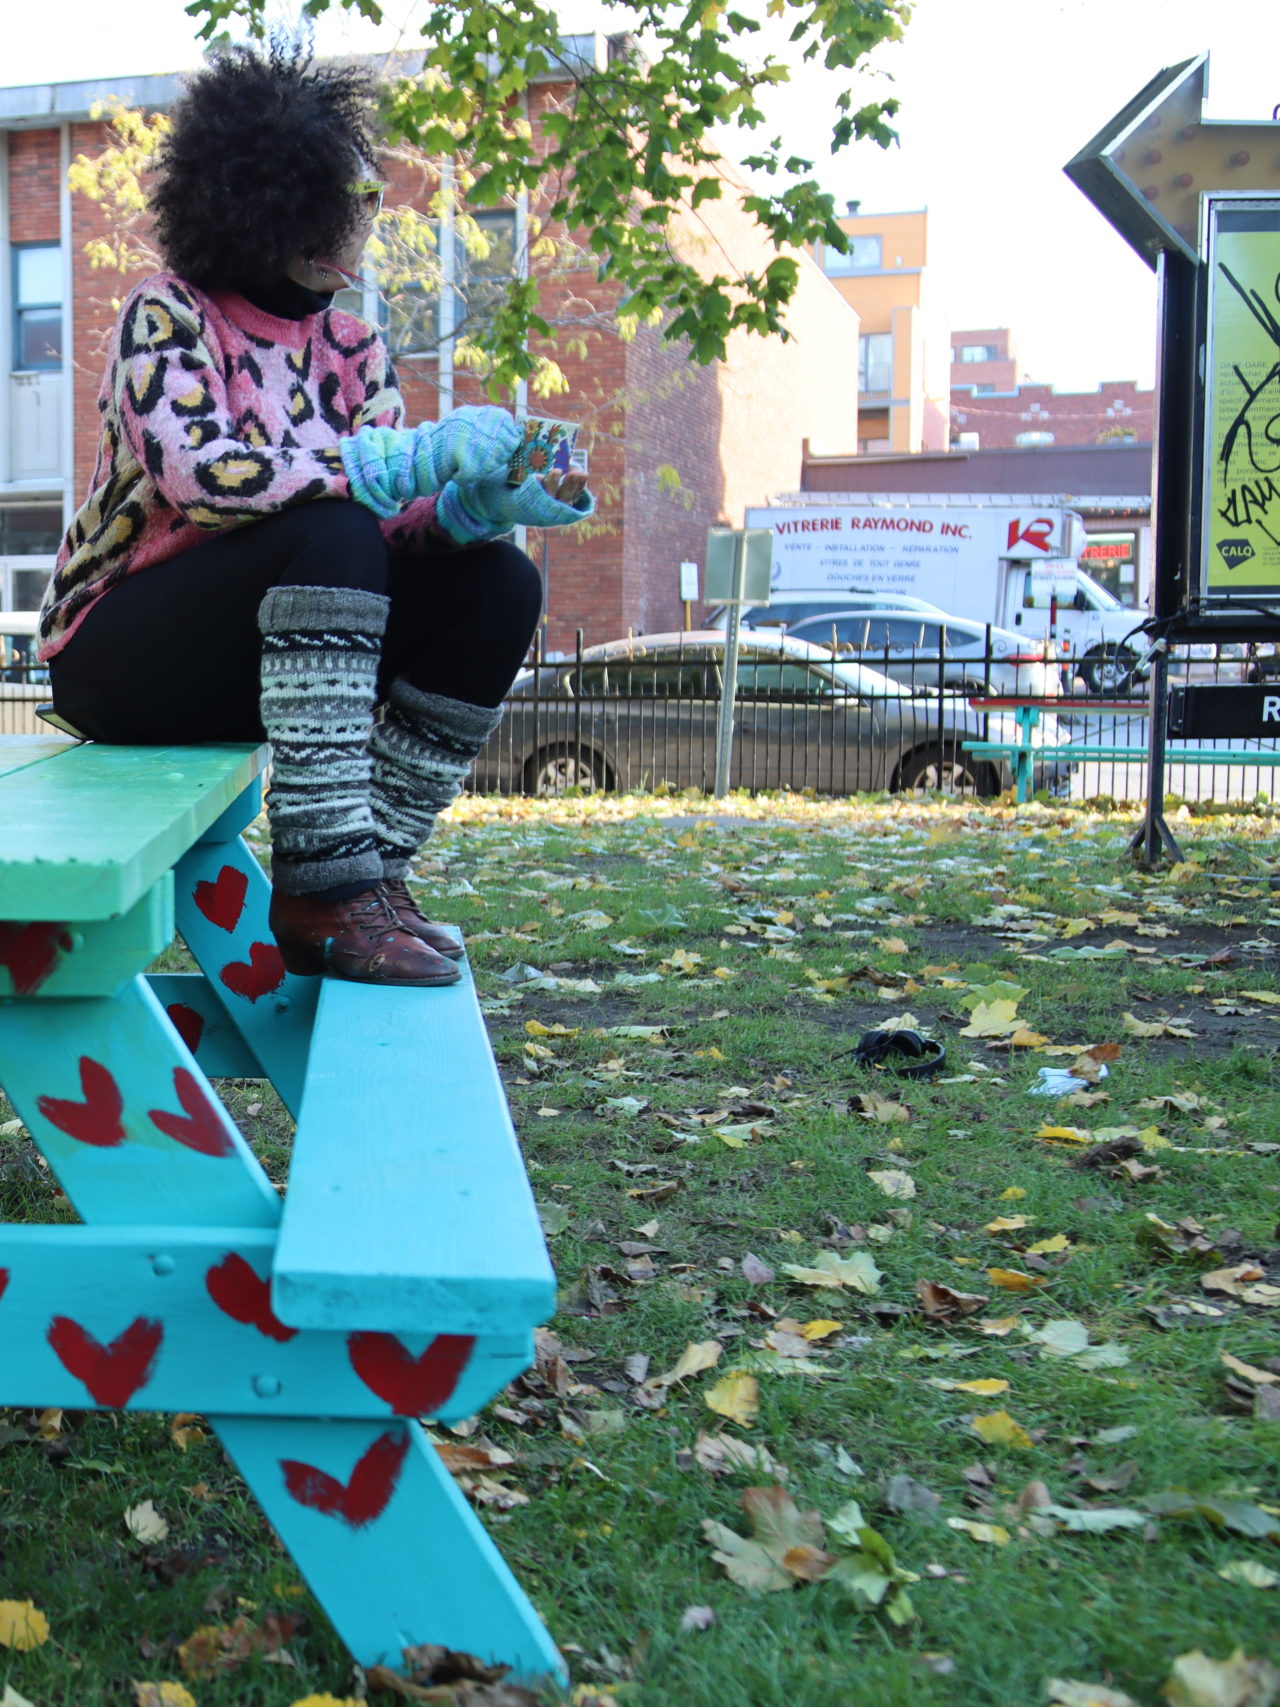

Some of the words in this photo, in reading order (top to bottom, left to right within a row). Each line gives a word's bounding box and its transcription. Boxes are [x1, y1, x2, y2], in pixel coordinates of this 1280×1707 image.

[775, 517, 842, 535] VITRERIE
[851, 517, 933, 533] RAYMOND
[940, 522, 972, 539] INC.
[784, 543, 813, 552] VENTE
[824, 543, 885, 553] INSTALLATION
[1078, 543, 1130, 561] TRERIE
[1221, 546, 1253, 558] CALQ
